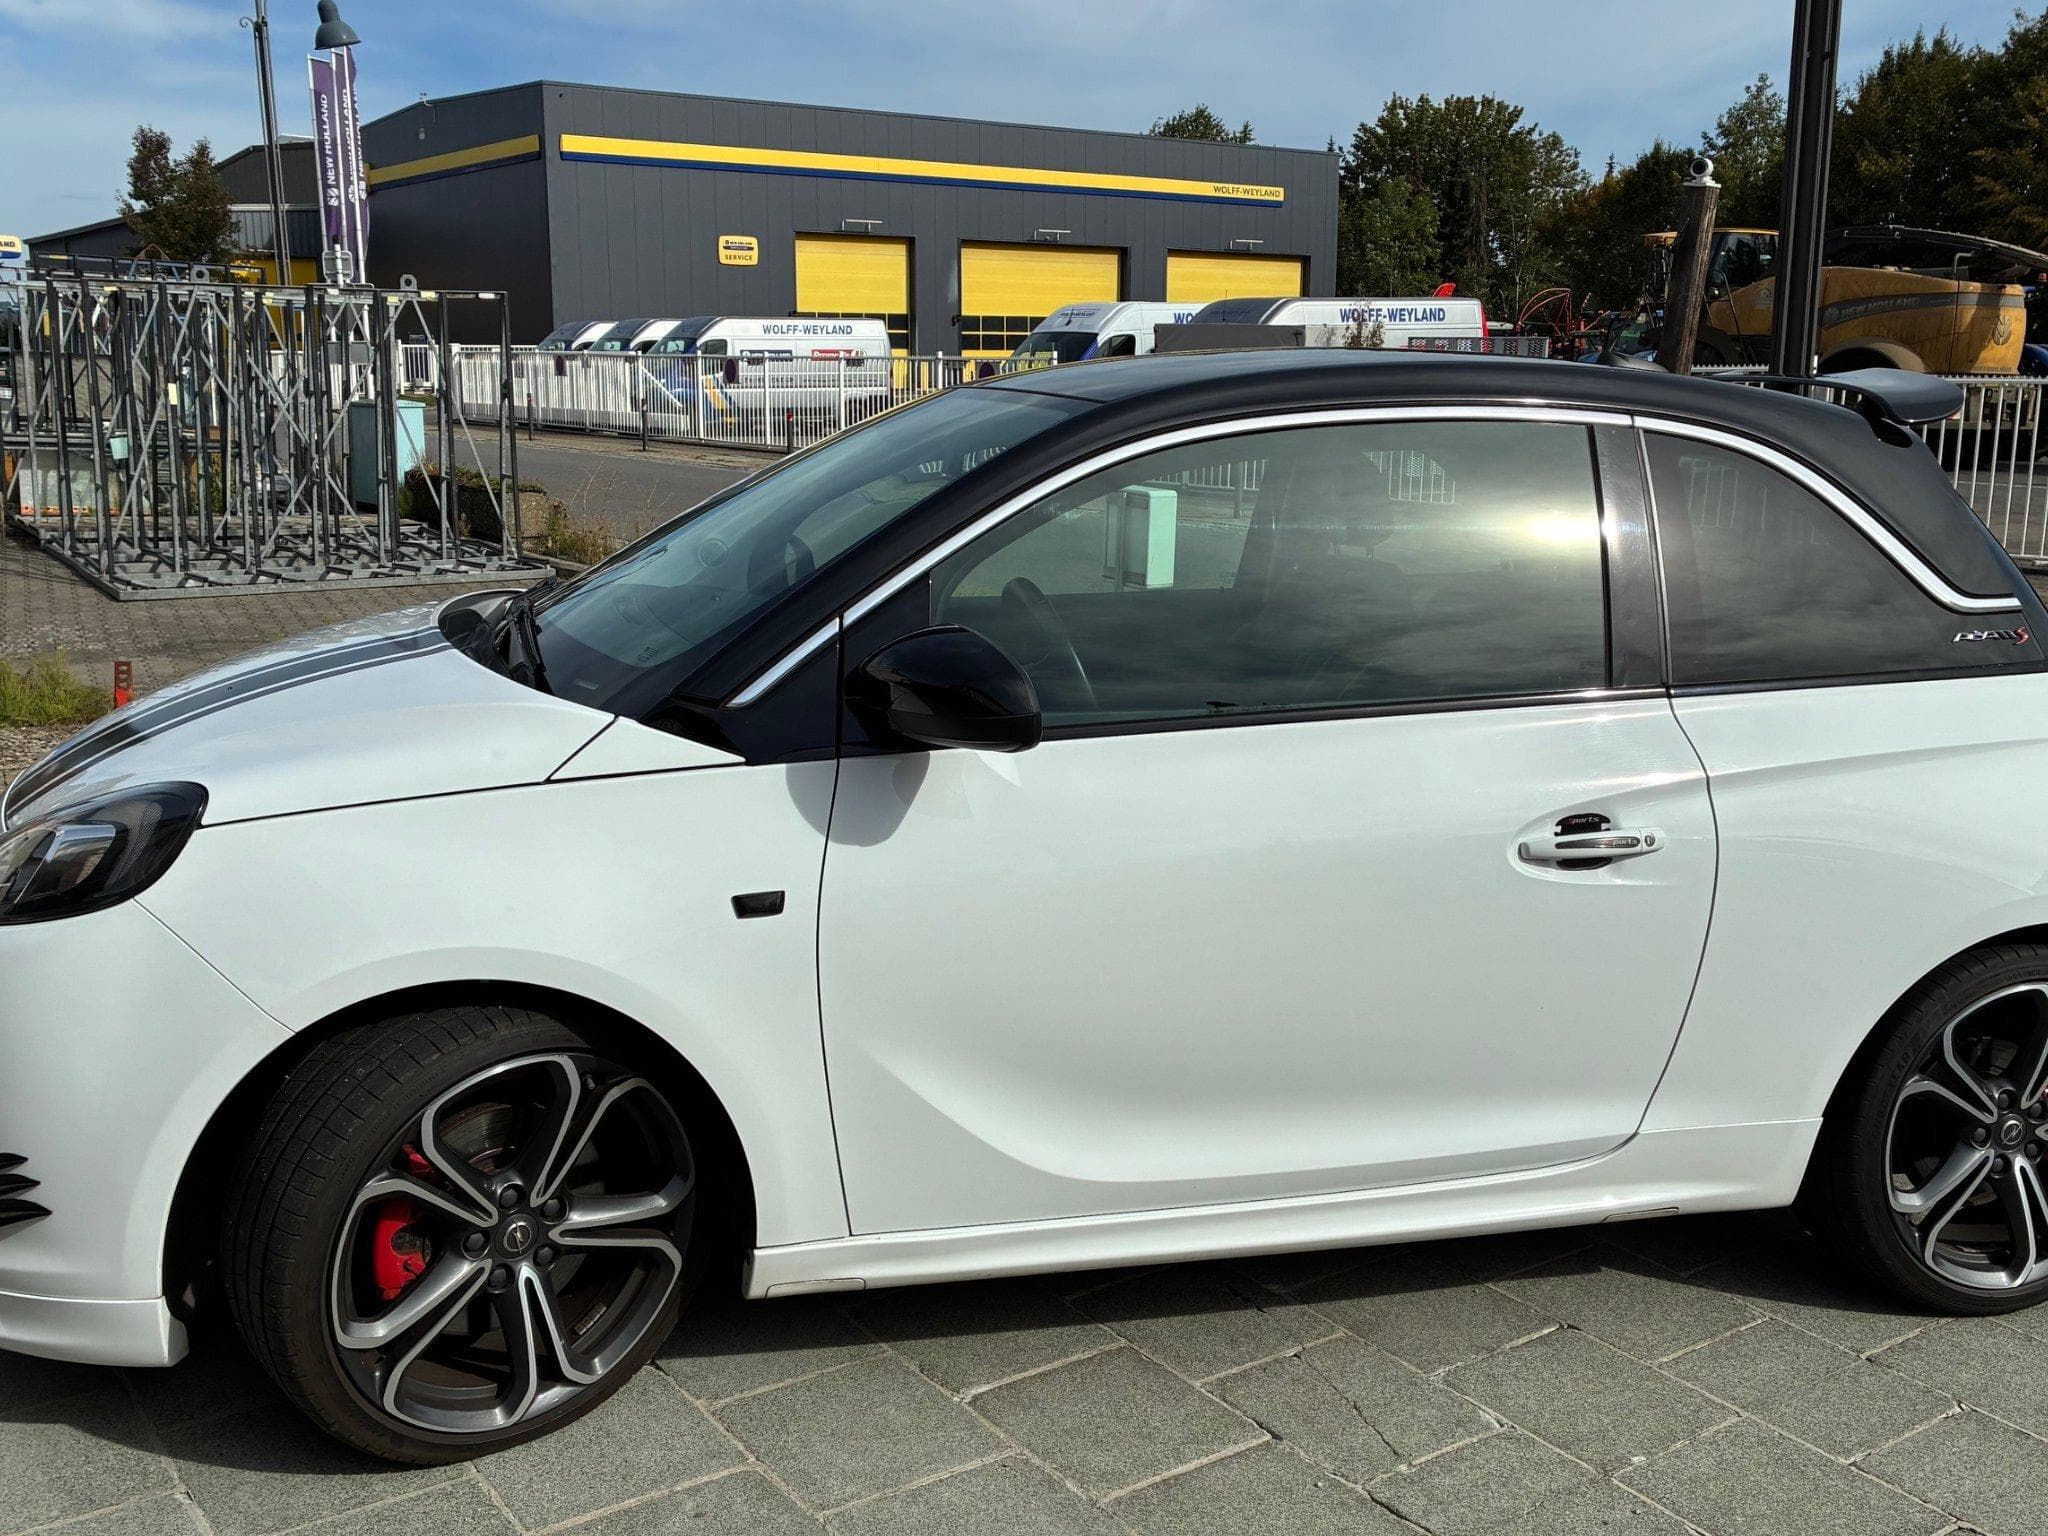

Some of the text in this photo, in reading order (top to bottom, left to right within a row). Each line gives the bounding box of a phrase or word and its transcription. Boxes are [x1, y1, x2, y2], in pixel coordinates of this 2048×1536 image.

[320, 94, 336, 185] NEW HOLLAND
[1213, 185, 1281, 198] WOLFF-WEYLAND
[1340, 307, 1446, 323] WOLFF-WEYLAND
[762, 324, 853, 335] WOLFF-WEYLAND
